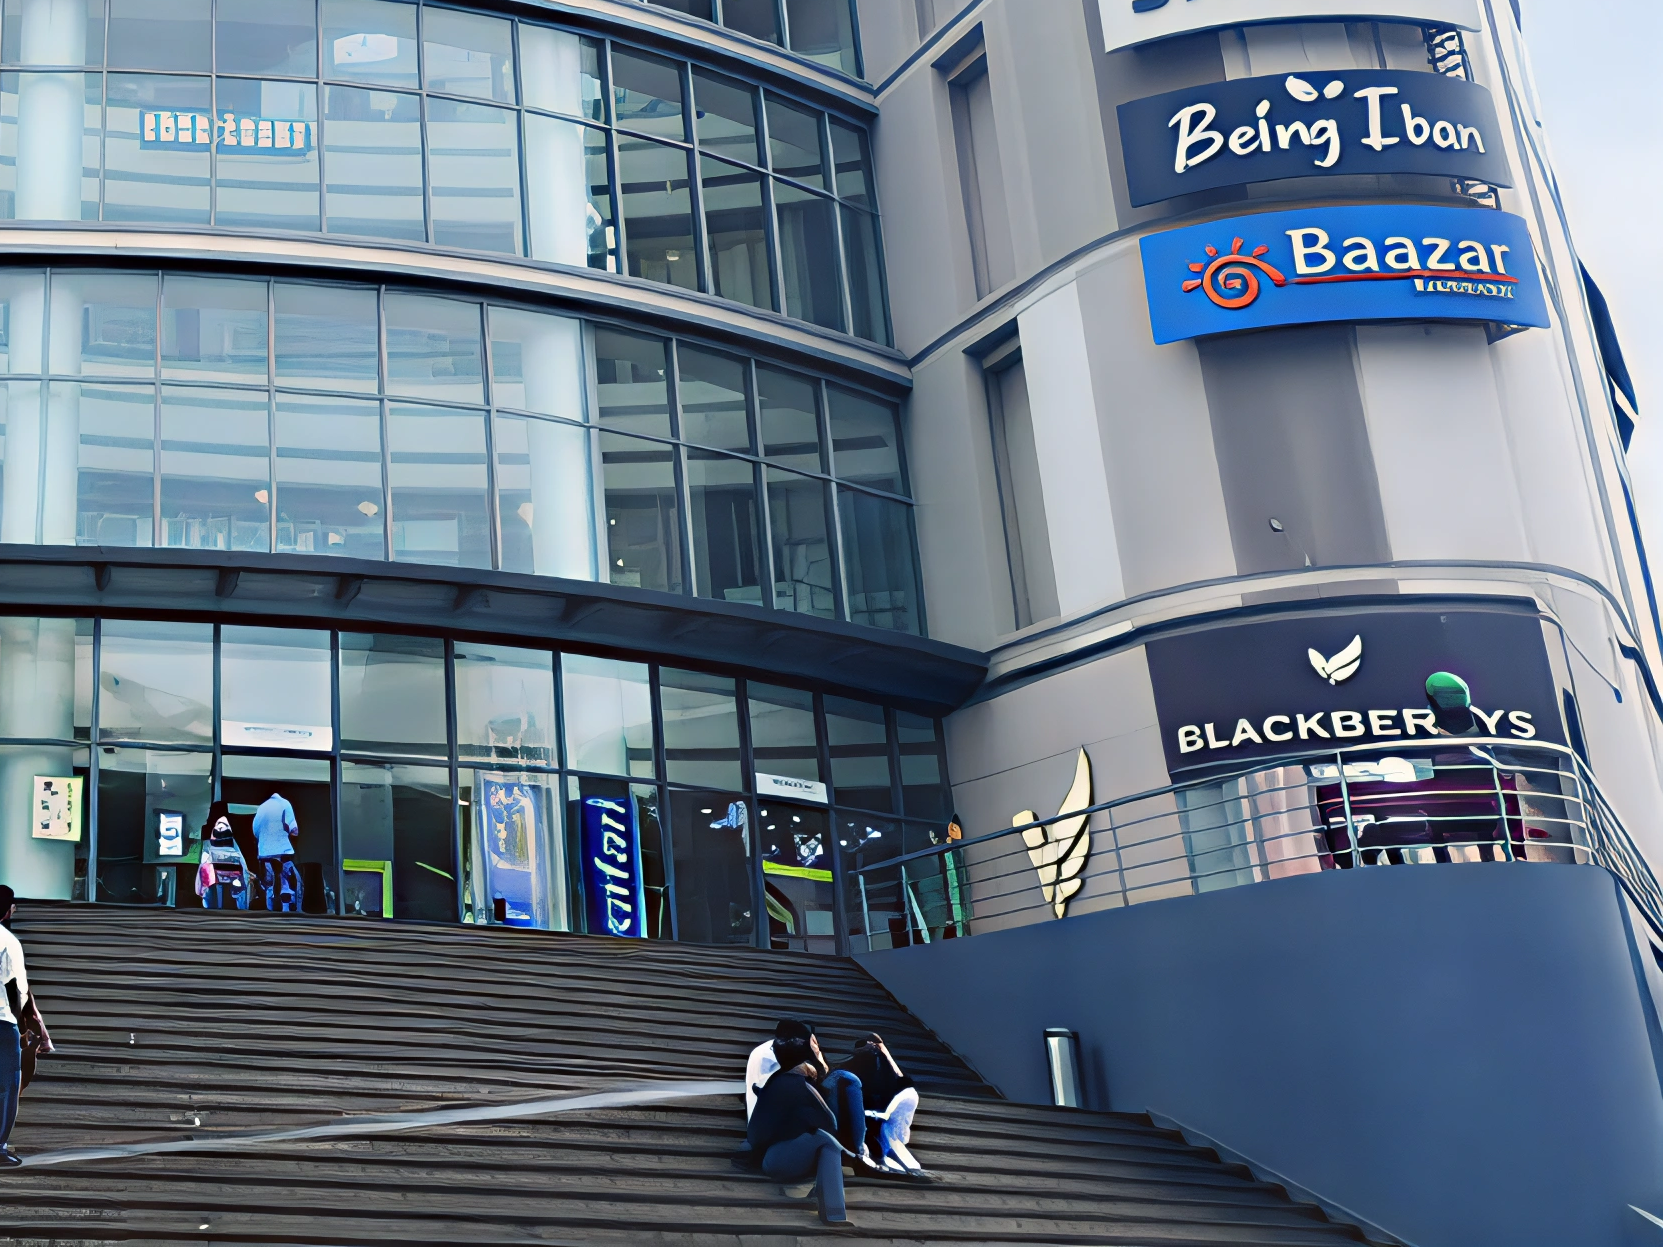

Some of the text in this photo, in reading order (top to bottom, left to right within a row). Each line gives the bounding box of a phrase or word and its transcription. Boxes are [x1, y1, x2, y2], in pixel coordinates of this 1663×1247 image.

[1168, 98, 1341, 175] Being
[1285, 227, 1511, 276] Baazar
[1177, 708, 1536, 754] BLACKBERYS
